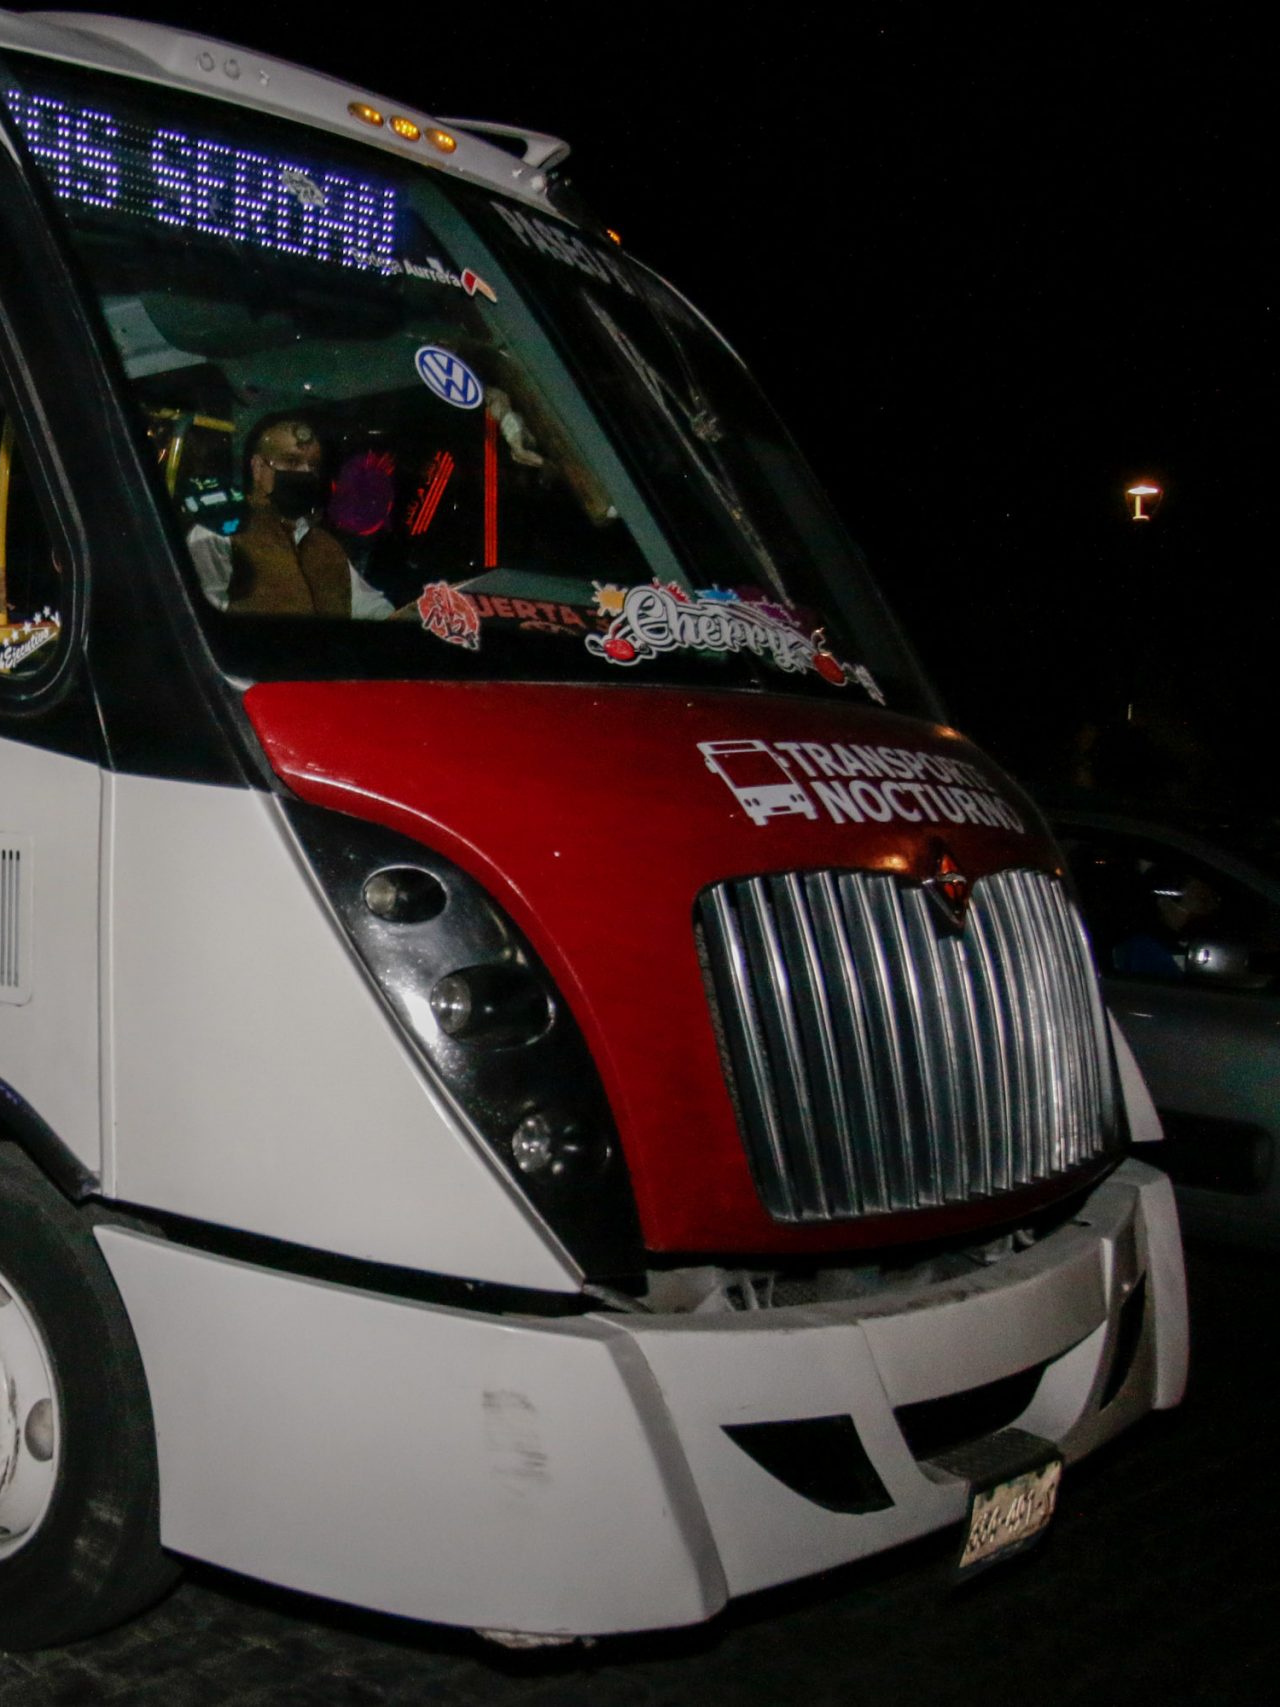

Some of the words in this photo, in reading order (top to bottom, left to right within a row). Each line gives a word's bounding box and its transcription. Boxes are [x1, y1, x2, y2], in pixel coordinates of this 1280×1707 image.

[151, 127, 397, 277] SERDAN
[773, 741, 996, 793] TRANSPORTE
[808, 779, 1025, 834] NOCTURNO
